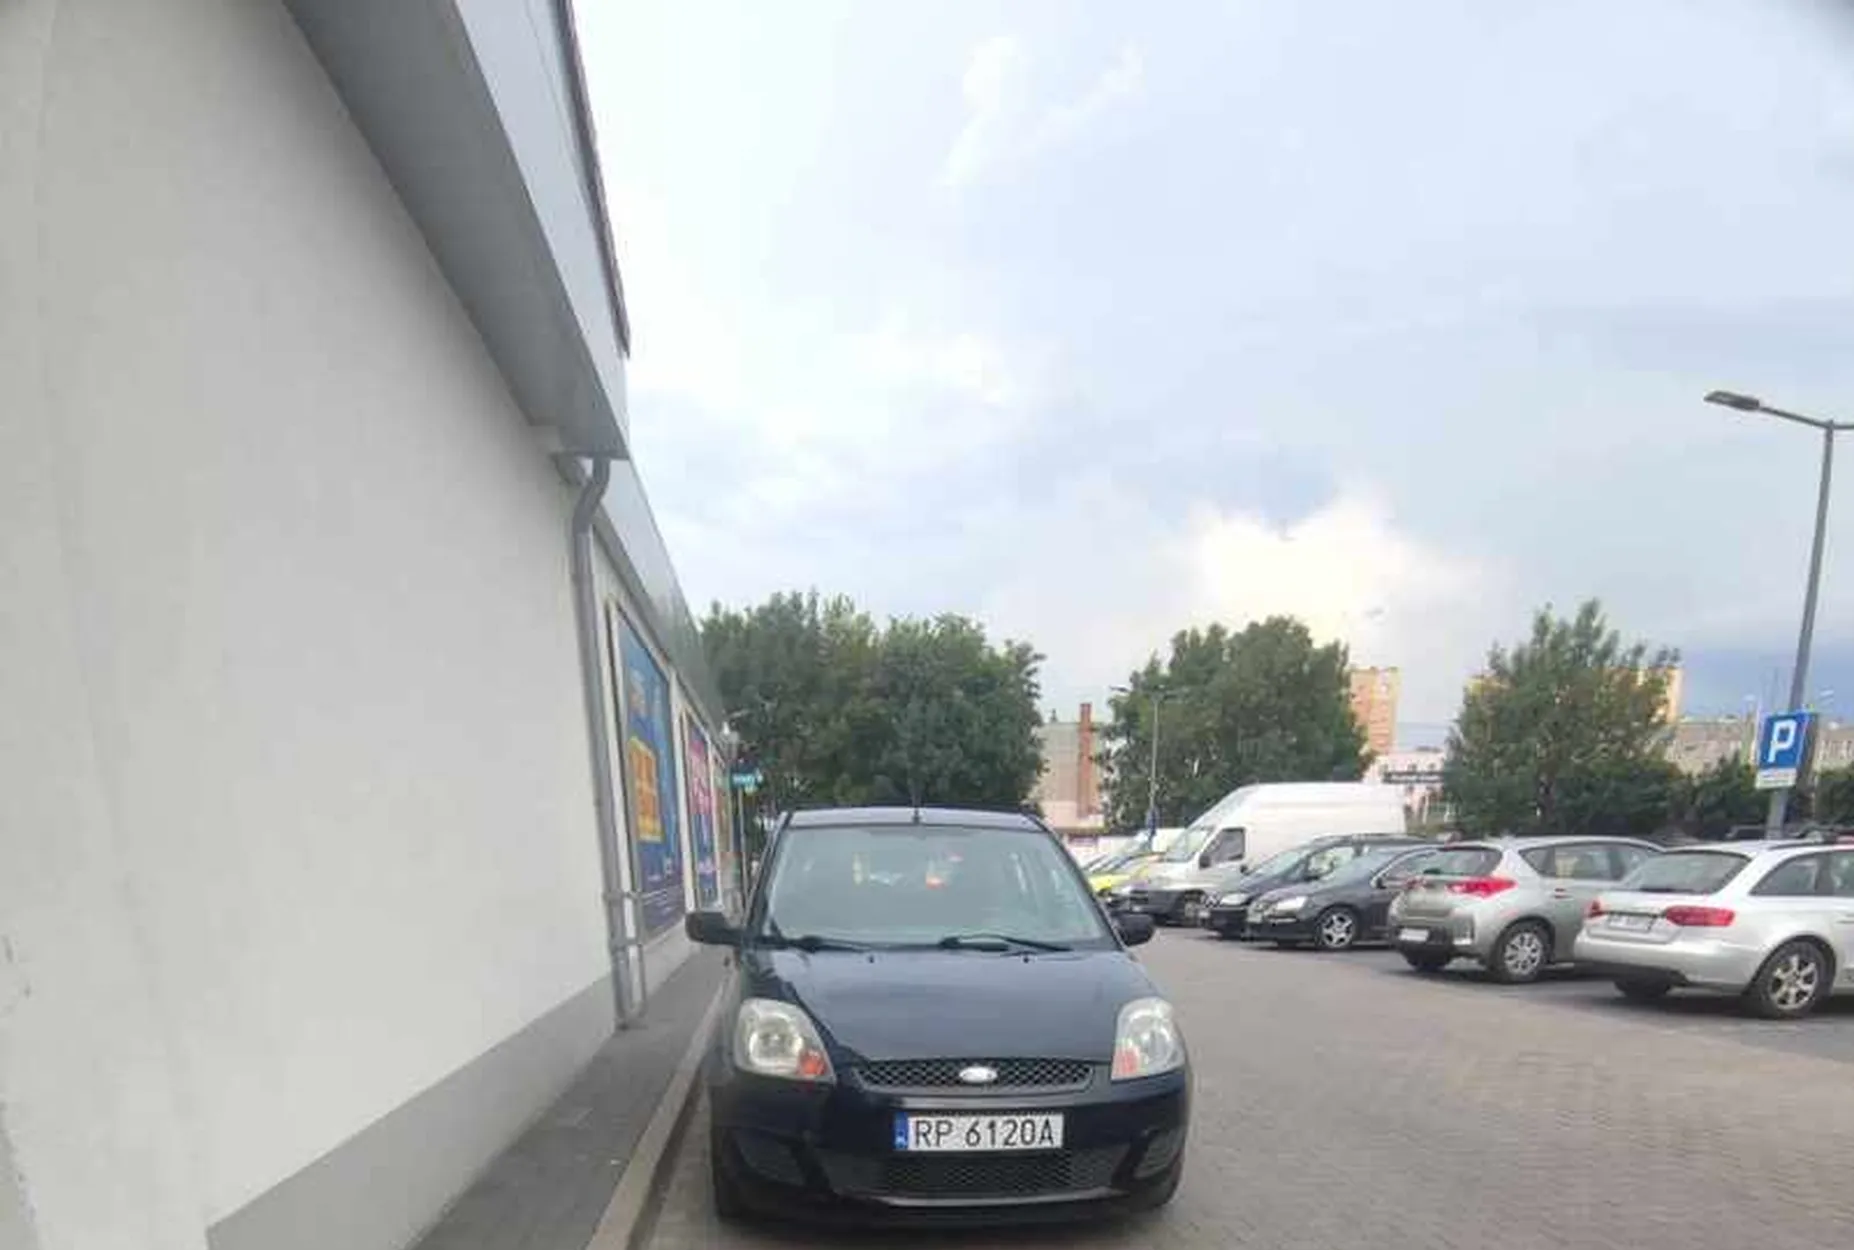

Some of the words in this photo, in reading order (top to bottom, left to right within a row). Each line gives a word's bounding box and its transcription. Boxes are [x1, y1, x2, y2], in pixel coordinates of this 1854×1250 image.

[1767, 718, 1797, 763] P
[915, 1119, 953, 1147] RP
[964, 1118, 1055, 1147] 6120A
